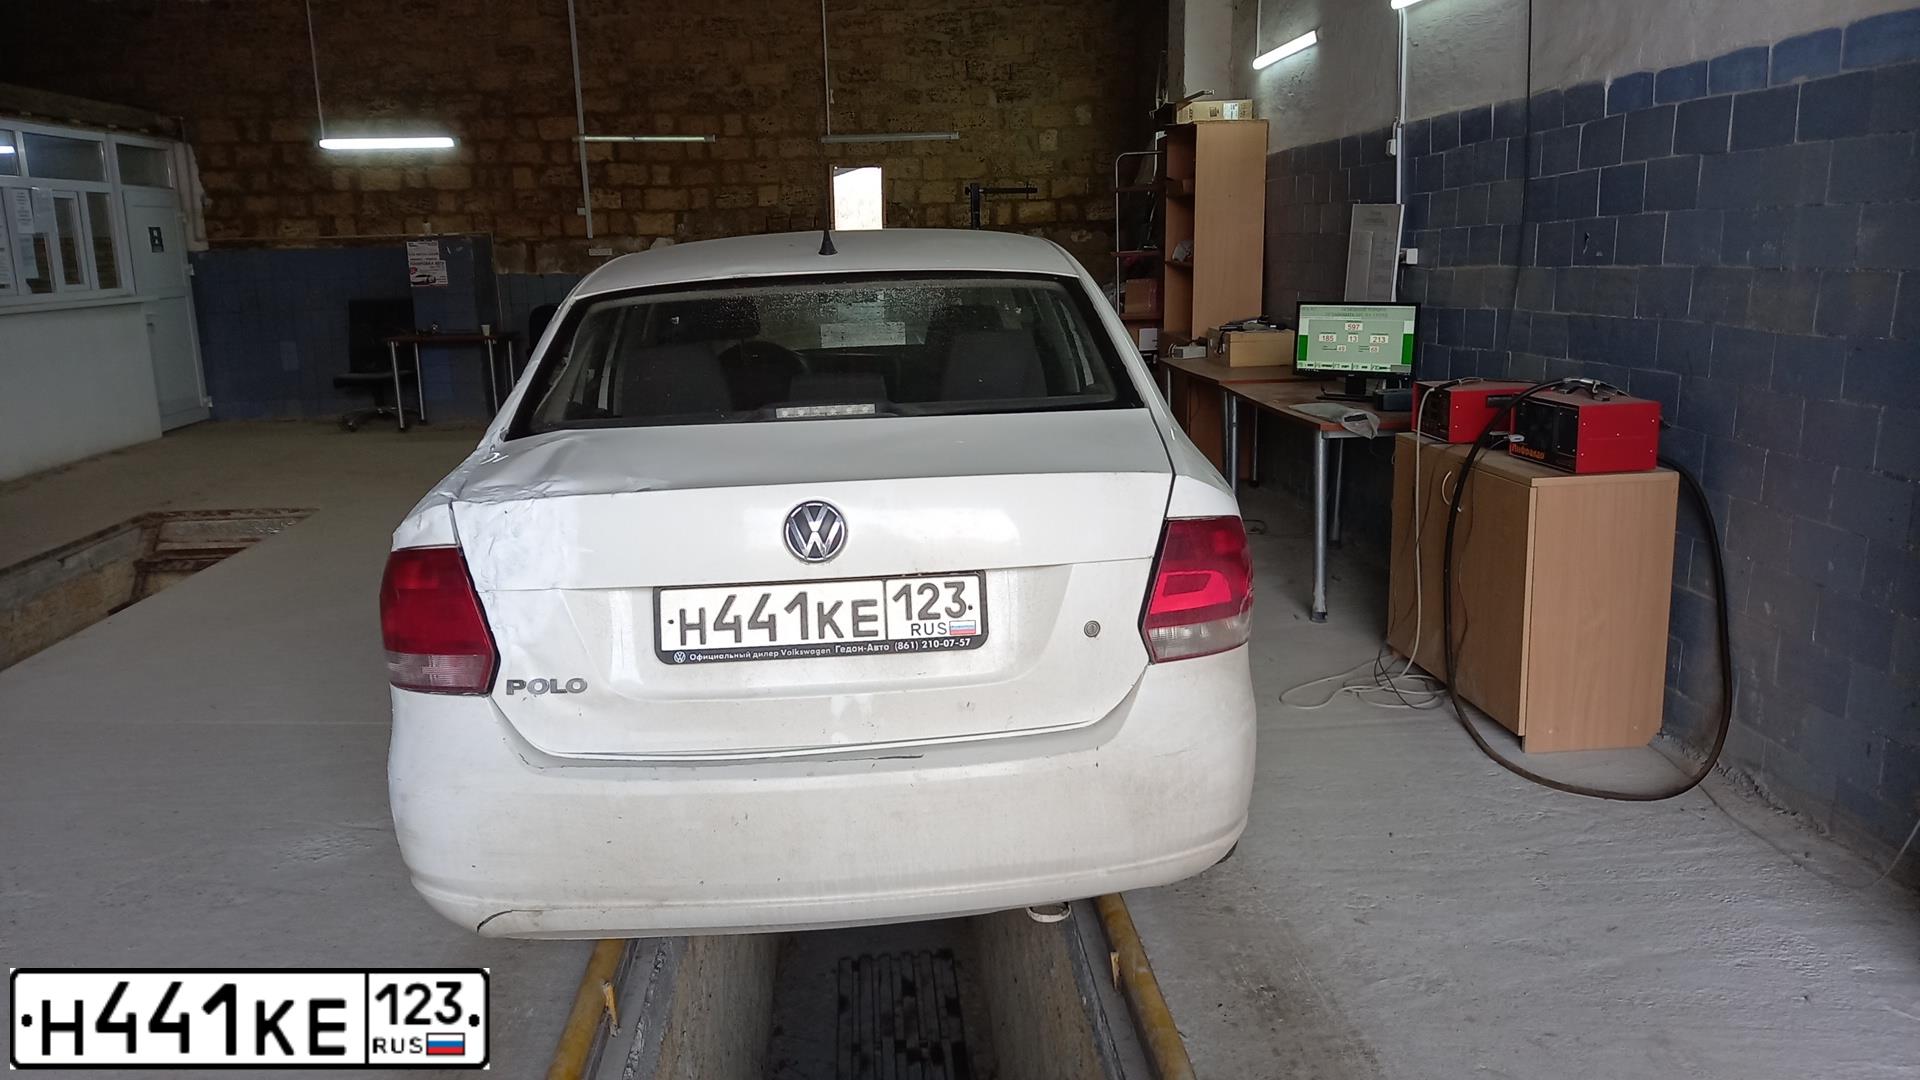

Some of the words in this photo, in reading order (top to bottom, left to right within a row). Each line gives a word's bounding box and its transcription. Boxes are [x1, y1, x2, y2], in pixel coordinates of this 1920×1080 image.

[891, 581, 967, 621] 123
[910, 622, 947, 636] RUS
[689, 650, 751, 662] Официальный
[752, 649, 779, 659] дилер
[781, 647, 831, 657] Volkswagen
[835, 643, 890, 654] Гедон-Авто
[894, 640, 919, 652] (861)
[921, 638, 971, 649] 210-07-57
[506, 677, 588, 695] POLO
